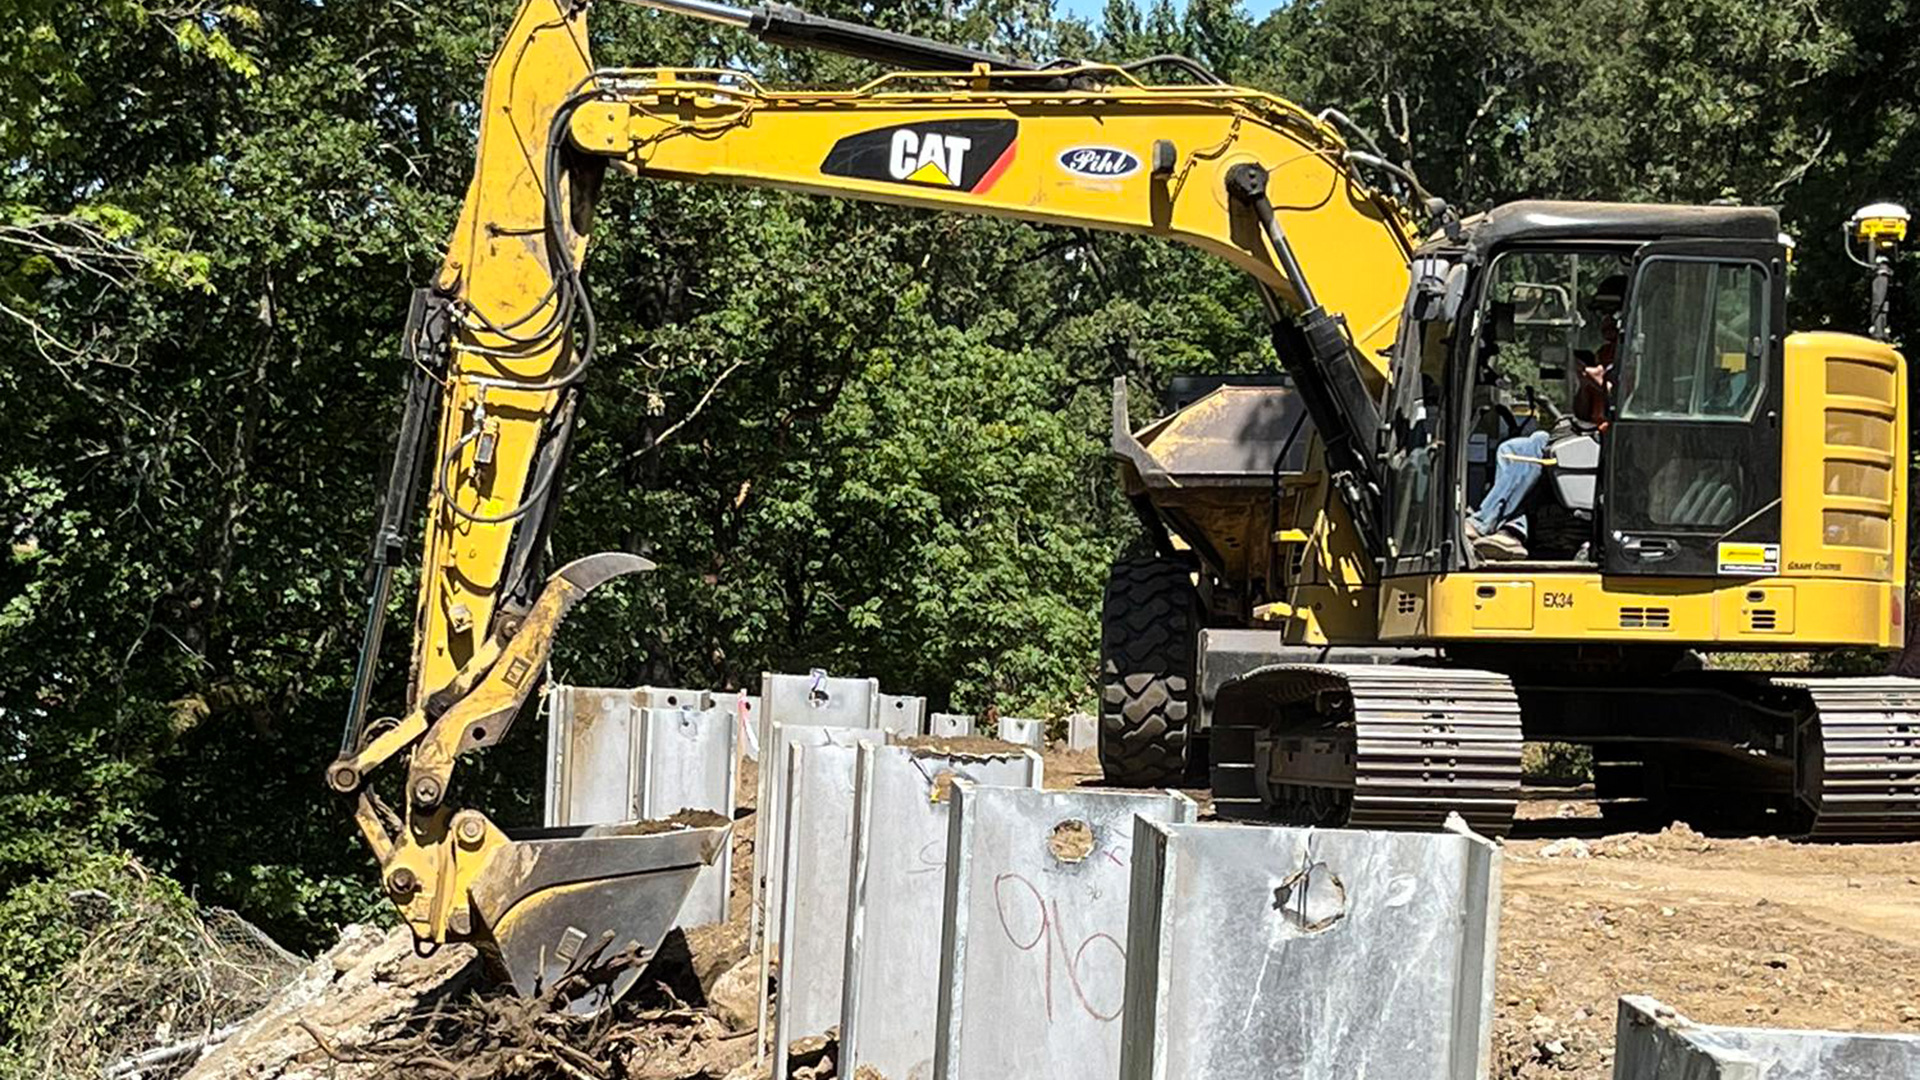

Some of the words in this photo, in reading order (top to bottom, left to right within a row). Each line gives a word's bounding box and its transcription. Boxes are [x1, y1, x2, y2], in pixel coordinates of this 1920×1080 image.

[889, 129, 972, 187] CAT
[1070, 150, 1127, 173] Pihl
[1543, 592, 1574, 608] EX34
[994, 873, 1127, 1023] 96
